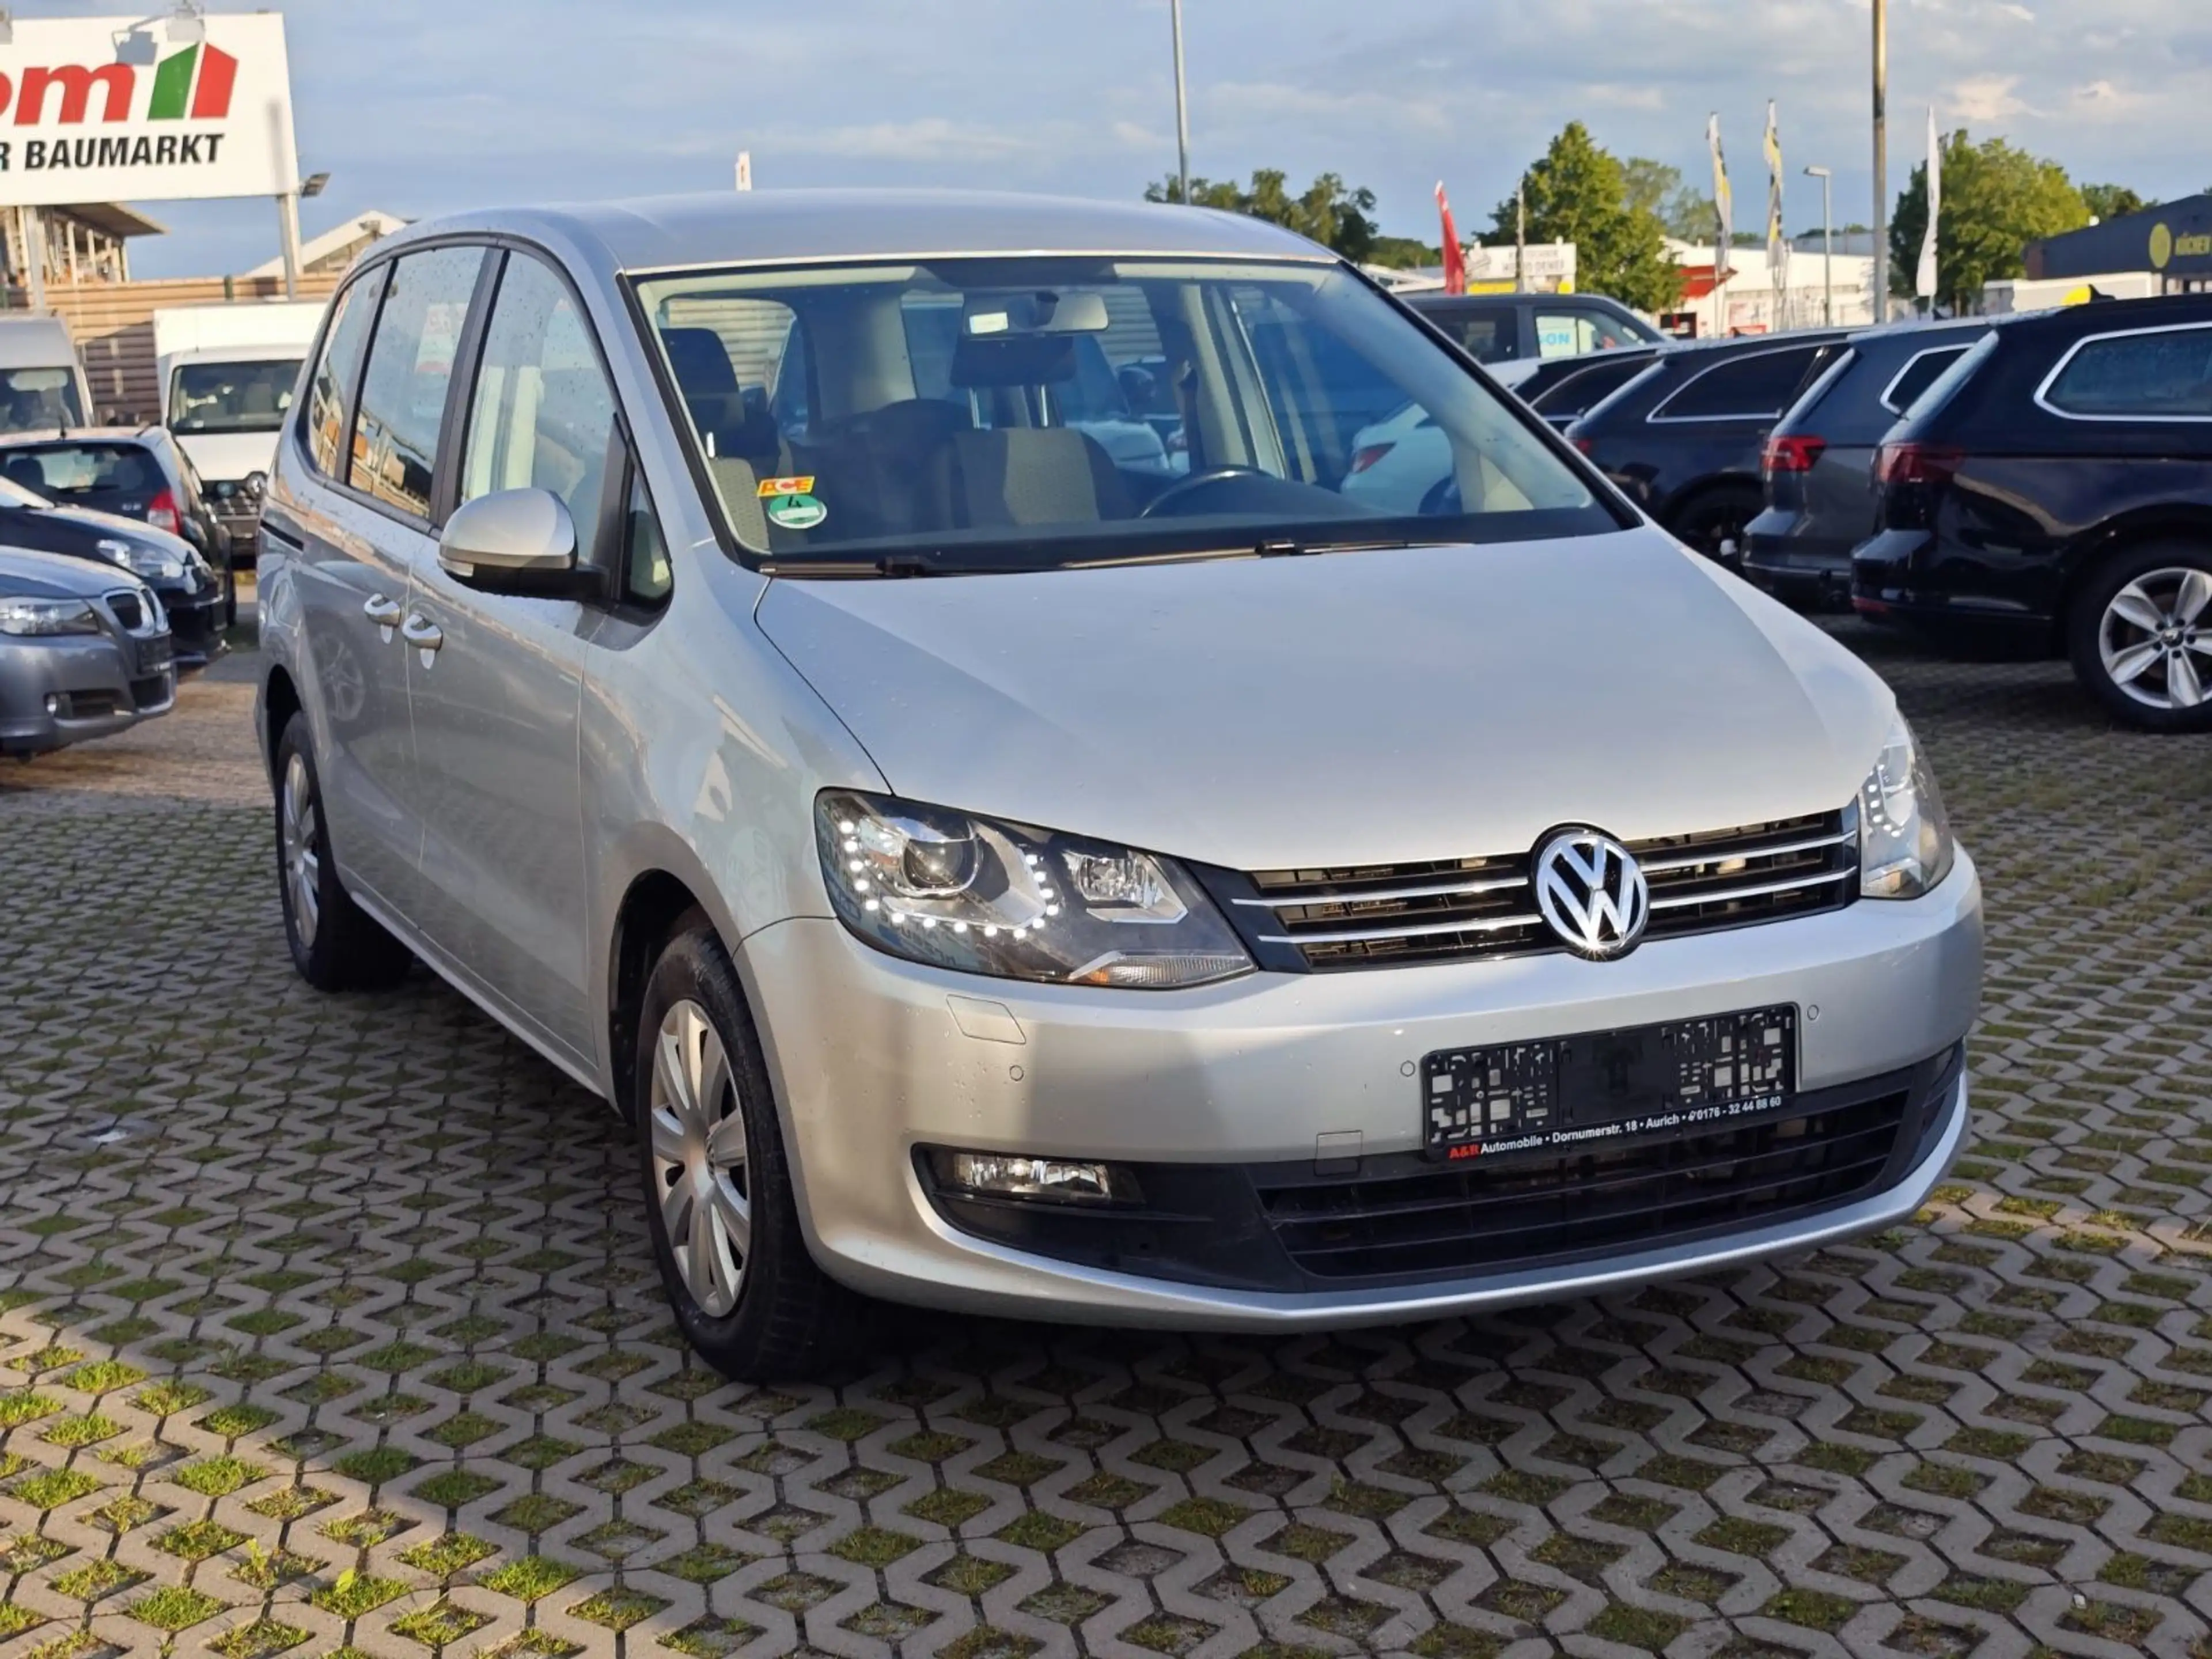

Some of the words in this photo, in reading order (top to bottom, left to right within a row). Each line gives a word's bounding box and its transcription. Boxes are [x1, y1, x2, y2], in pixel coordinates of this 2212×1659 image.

[25, 133, 224, 171] BAUMARKT
[761, 477, 809, 494] ACE
[787, 495, 802, 508] 4
[1480, 1135, 1543, 1154] Automobile
[1552, 1124, 1623, 1143] Dornumerstr.
[1625, 1120, 1638, 1131] 18
[1645, 1114, 1679, 1128] Aurich
[1728, 1103, 1740, 1115] 32
